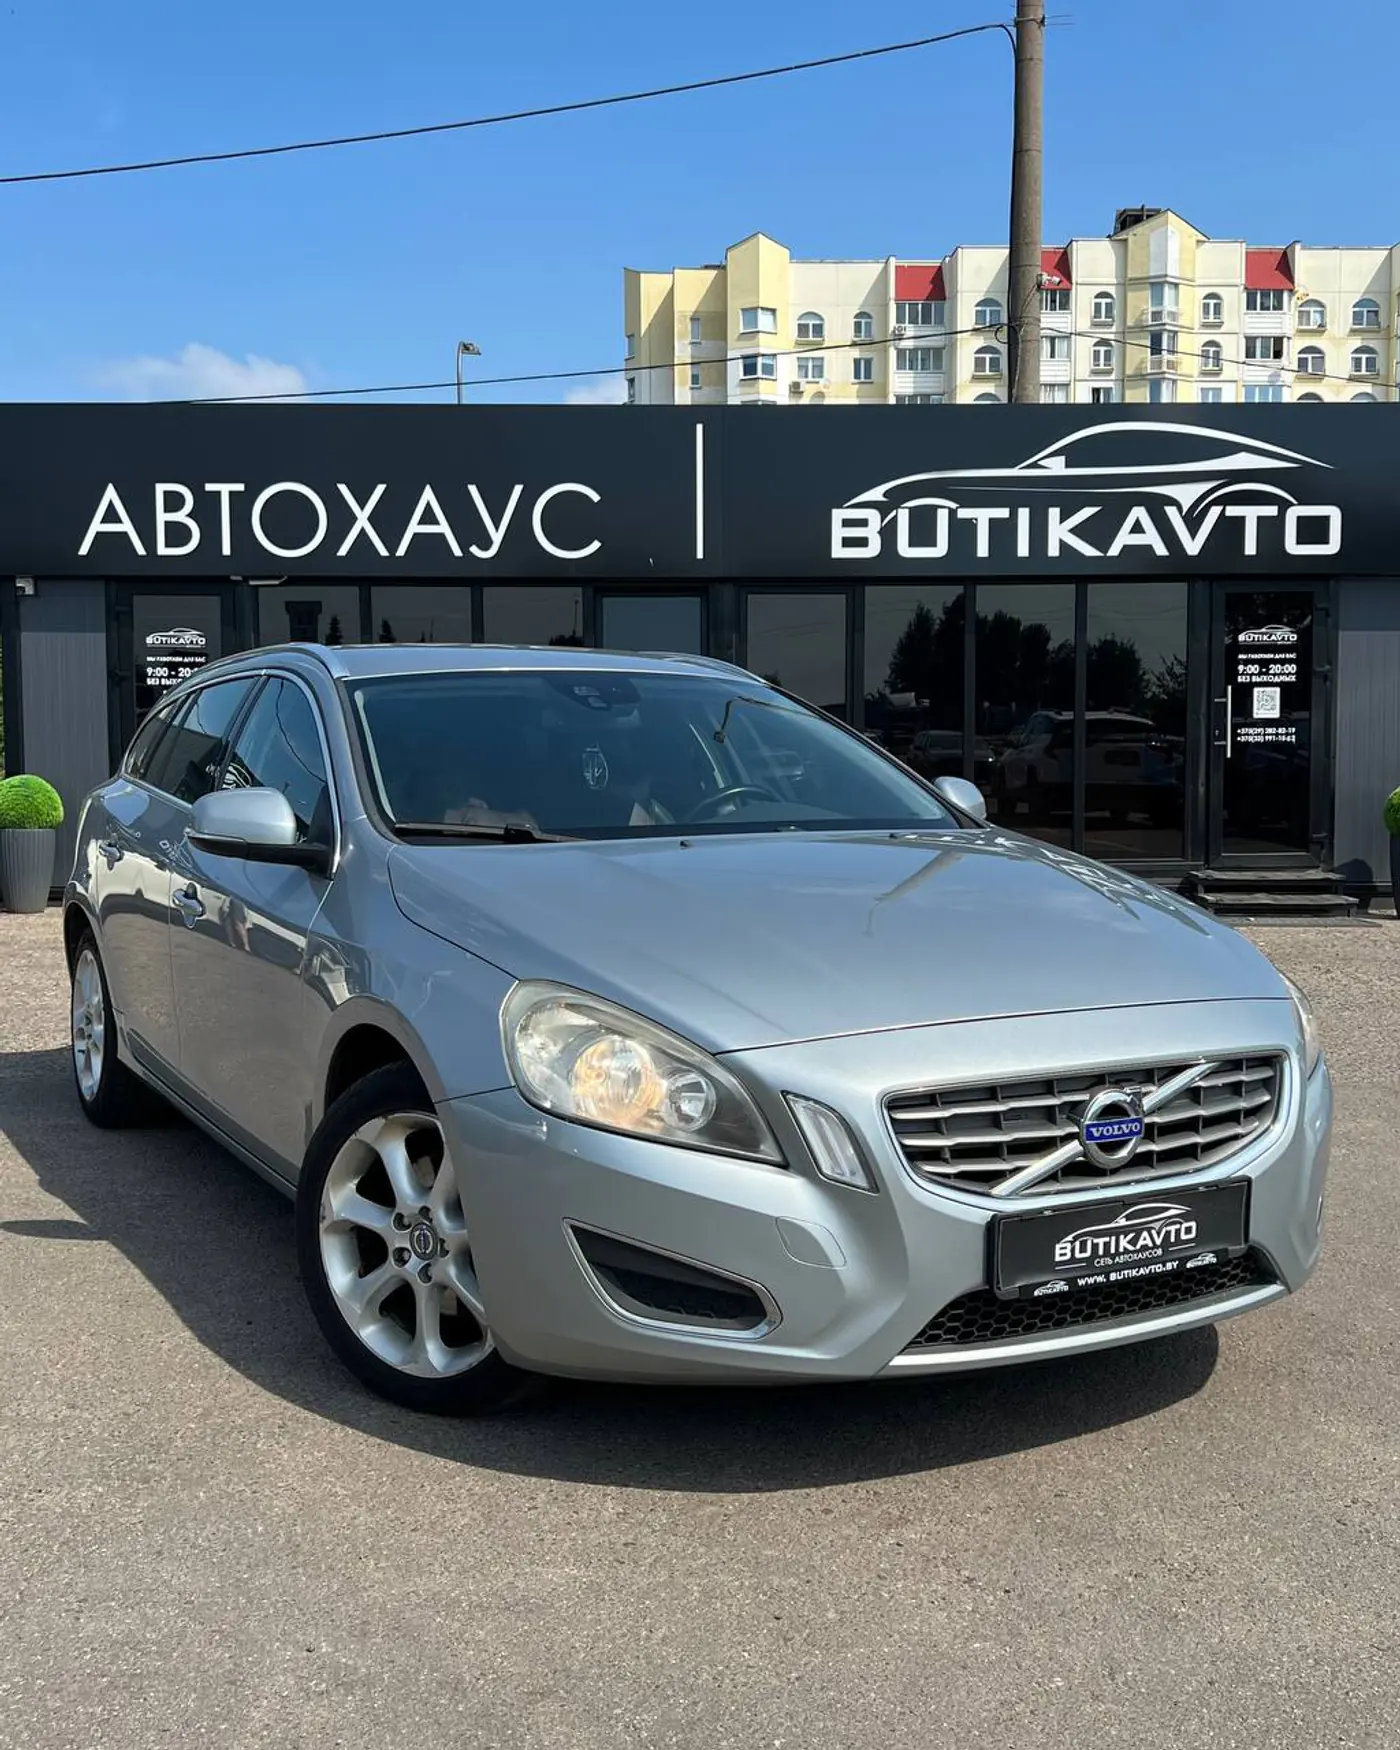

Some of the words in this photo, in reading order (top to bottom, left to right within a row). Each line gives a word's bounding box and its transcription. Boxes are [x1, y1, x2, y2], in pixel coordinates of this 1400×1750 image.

[78, 481, 603, 559] АВТОХАУС
[830, 504, 1342, 559] BUTIKAVTO
[146, 667, 169, 677] 9:00
[1237, 664, 1260, 674] 9:00
[1268, 664, 1297, 674] 20:00
[1237, 675, 1251, 683] БЕЗ
[1251, 675, 1297, 683] ВЫХОДНЫХ
[1089, 1122, 1141, 1138] VOLVO
[1055, 1220, 1197, 1262] BUTIKAVTO
[1094, 1256, 1113, 1267] СЕТЬ
[1113, 1248, 1163, 1265] АВТОХАУСОВ
[1077, 1274, 1107, 1287] WWW.
[1109, 1260, 1180, 1281] BUTIKAVTO.BY
